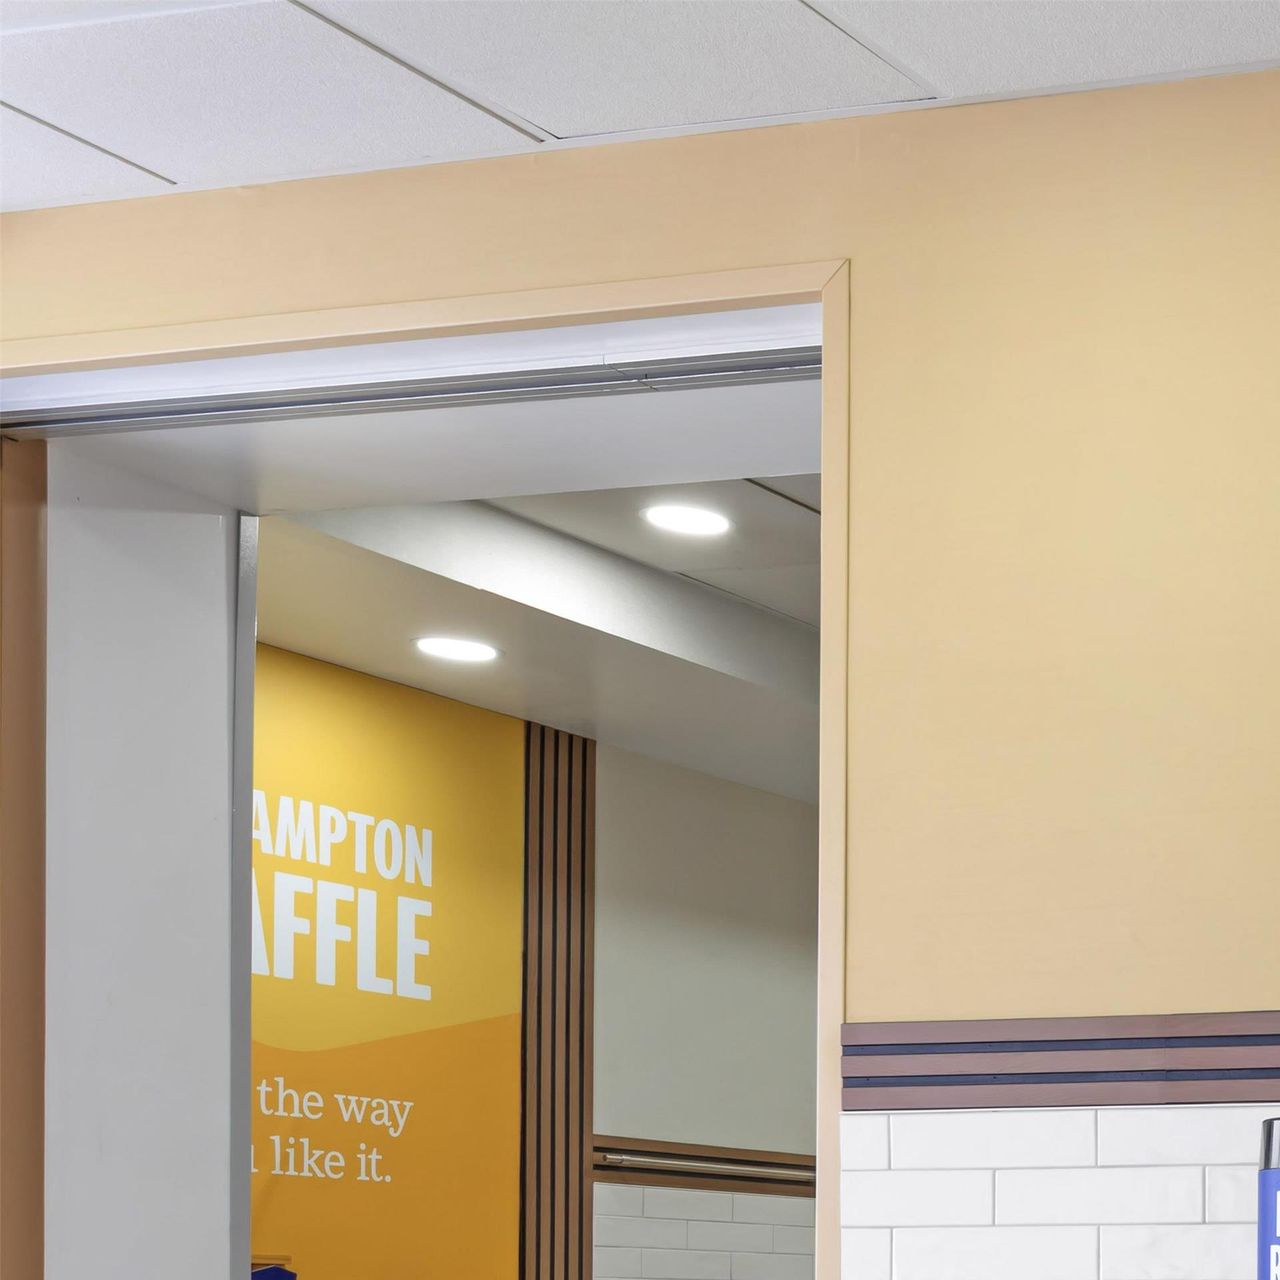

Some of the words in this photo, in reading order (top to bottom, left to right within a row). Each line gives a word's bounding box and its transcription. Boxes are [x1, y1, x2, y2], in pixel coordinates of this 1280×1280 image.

[256, 1077, 324, 1120] the
[334, 1094, 414, 1137] way
[270, 1135, 345, 1179] like
[357, 1143, 392, 1182] it.
